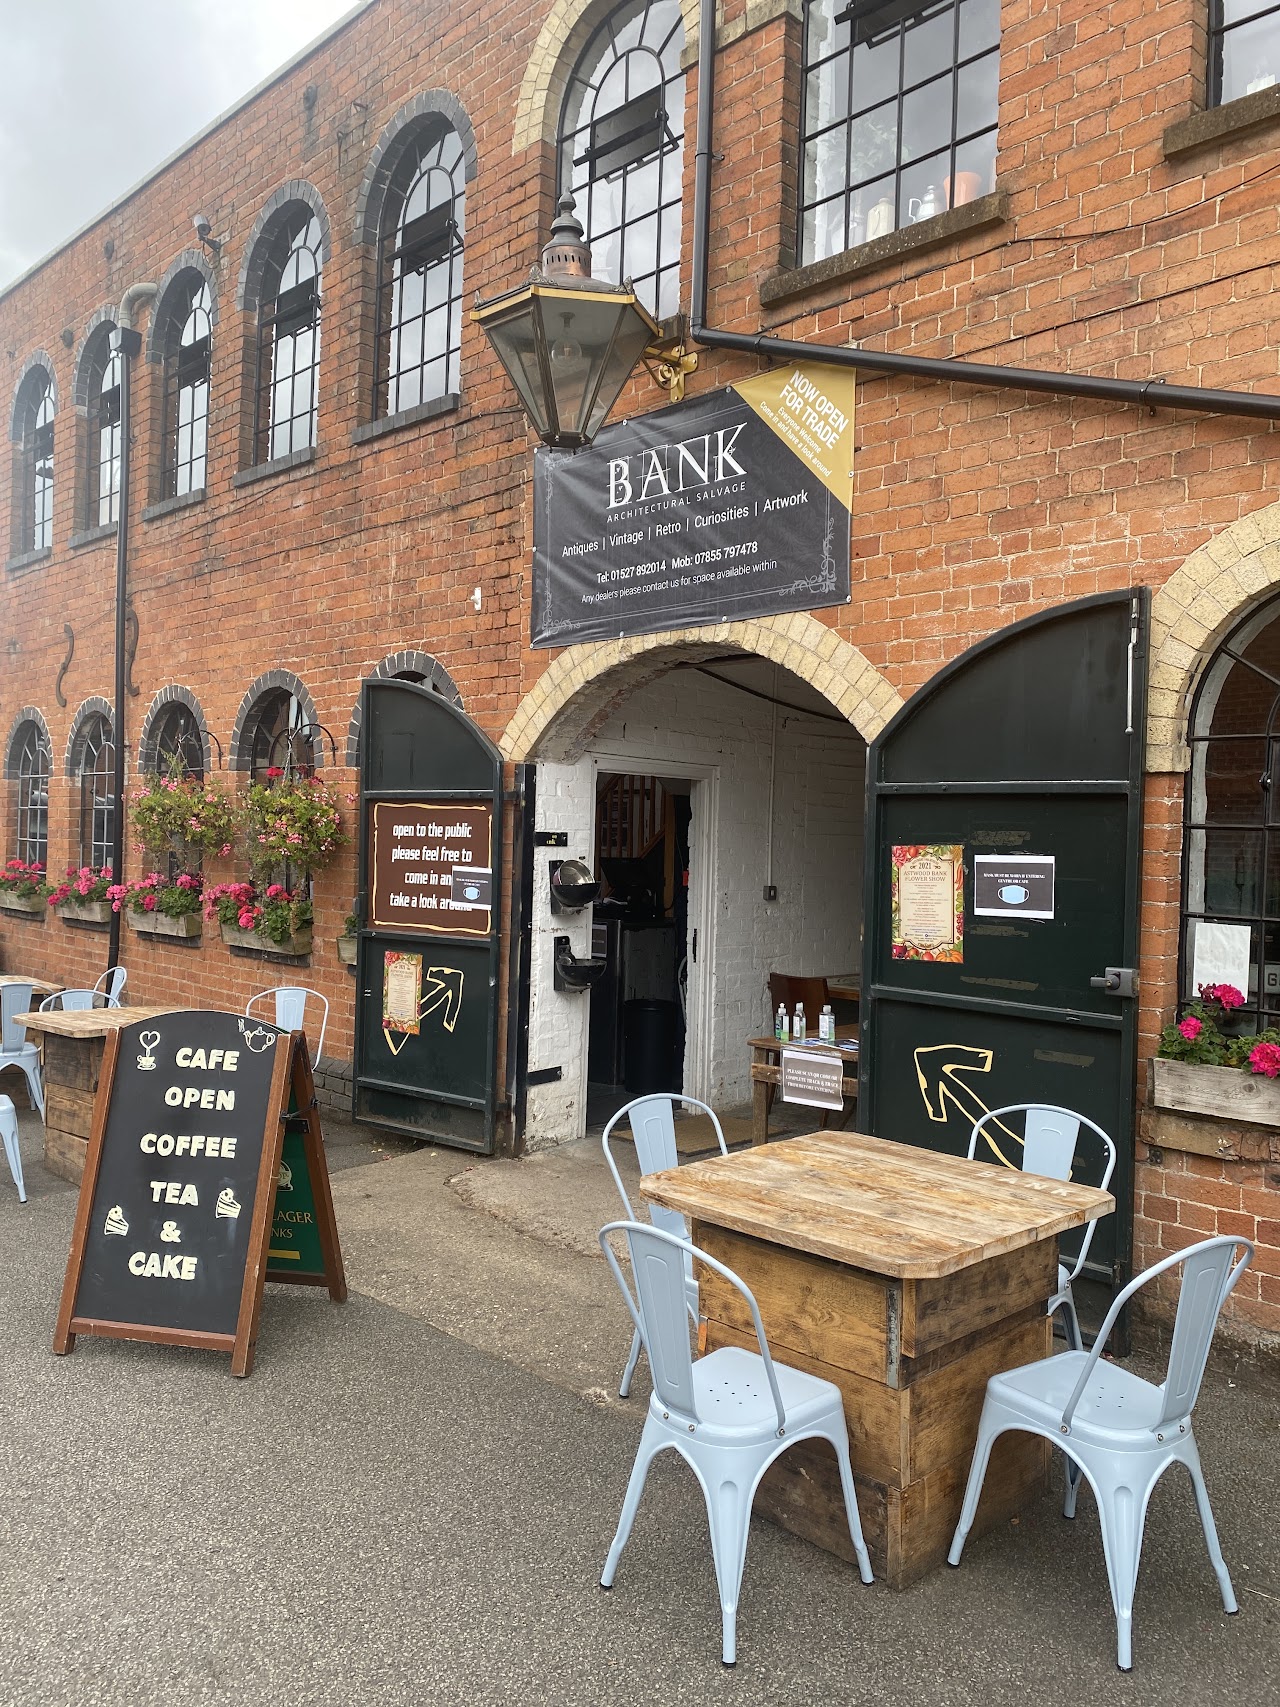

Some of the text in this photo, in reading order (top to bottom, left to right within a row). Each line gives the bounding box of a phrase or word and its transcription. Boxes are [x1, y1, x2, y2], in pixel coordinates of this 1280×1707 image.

[790, 369, 849, 434] NOW OPEN
[778, 406, 821, 453] Everyone Welcome
[779, 384, 840, 450] FOR TRADE
[760, 401, 773, 418] Come
[777, 420, 790, 433] and
[786, 427, 800, 445] have
[801, 444, 815, 460] look
[812, 457, 832, 477] around
[606, 422, 748, 510] BANK
[607, 481, 747, 523] ARCHITECTURAL SALVAGE
[562, 541, 599, 557] Antiques
[610, 530, 644, 546] Vintage
[656, 522, 681, 537] Retro
[694, 506, 749, 528] Curiosities
[763, 489, 809, 512] Artwork
[597, 541, 758, 584] Tel: 01527 892014 Mob: 07855 797478
[581, 558, 777, 604] Any dealers please contact us for space available within
[393, 822, 472, 840] open to the public
[391, 845, 472, 862] please feel free to
[918, 862, 932, 870] 2021
[404, 872, 428, 885] come
[429, 870, 438, 885] in
[440, 873, 452, 886] an
[389, 892, 410, 907] take
[411, 896, 417, 908] a
[419, 893, 438, 910] look
[175, 1047, 240, 1072] CAFE
[164, 1086, 236, 1111] OPEN
[140, 1133, 238, 1159] COFFEE
[150, 1180, 199, 1206] TEA
[976, 1170, 1076, 1197] BANK
[273, 1211, 314, 1224] AGER
[160, 1220, 181, 1243] &
[128, 1251, 198, 1280] CAKE
